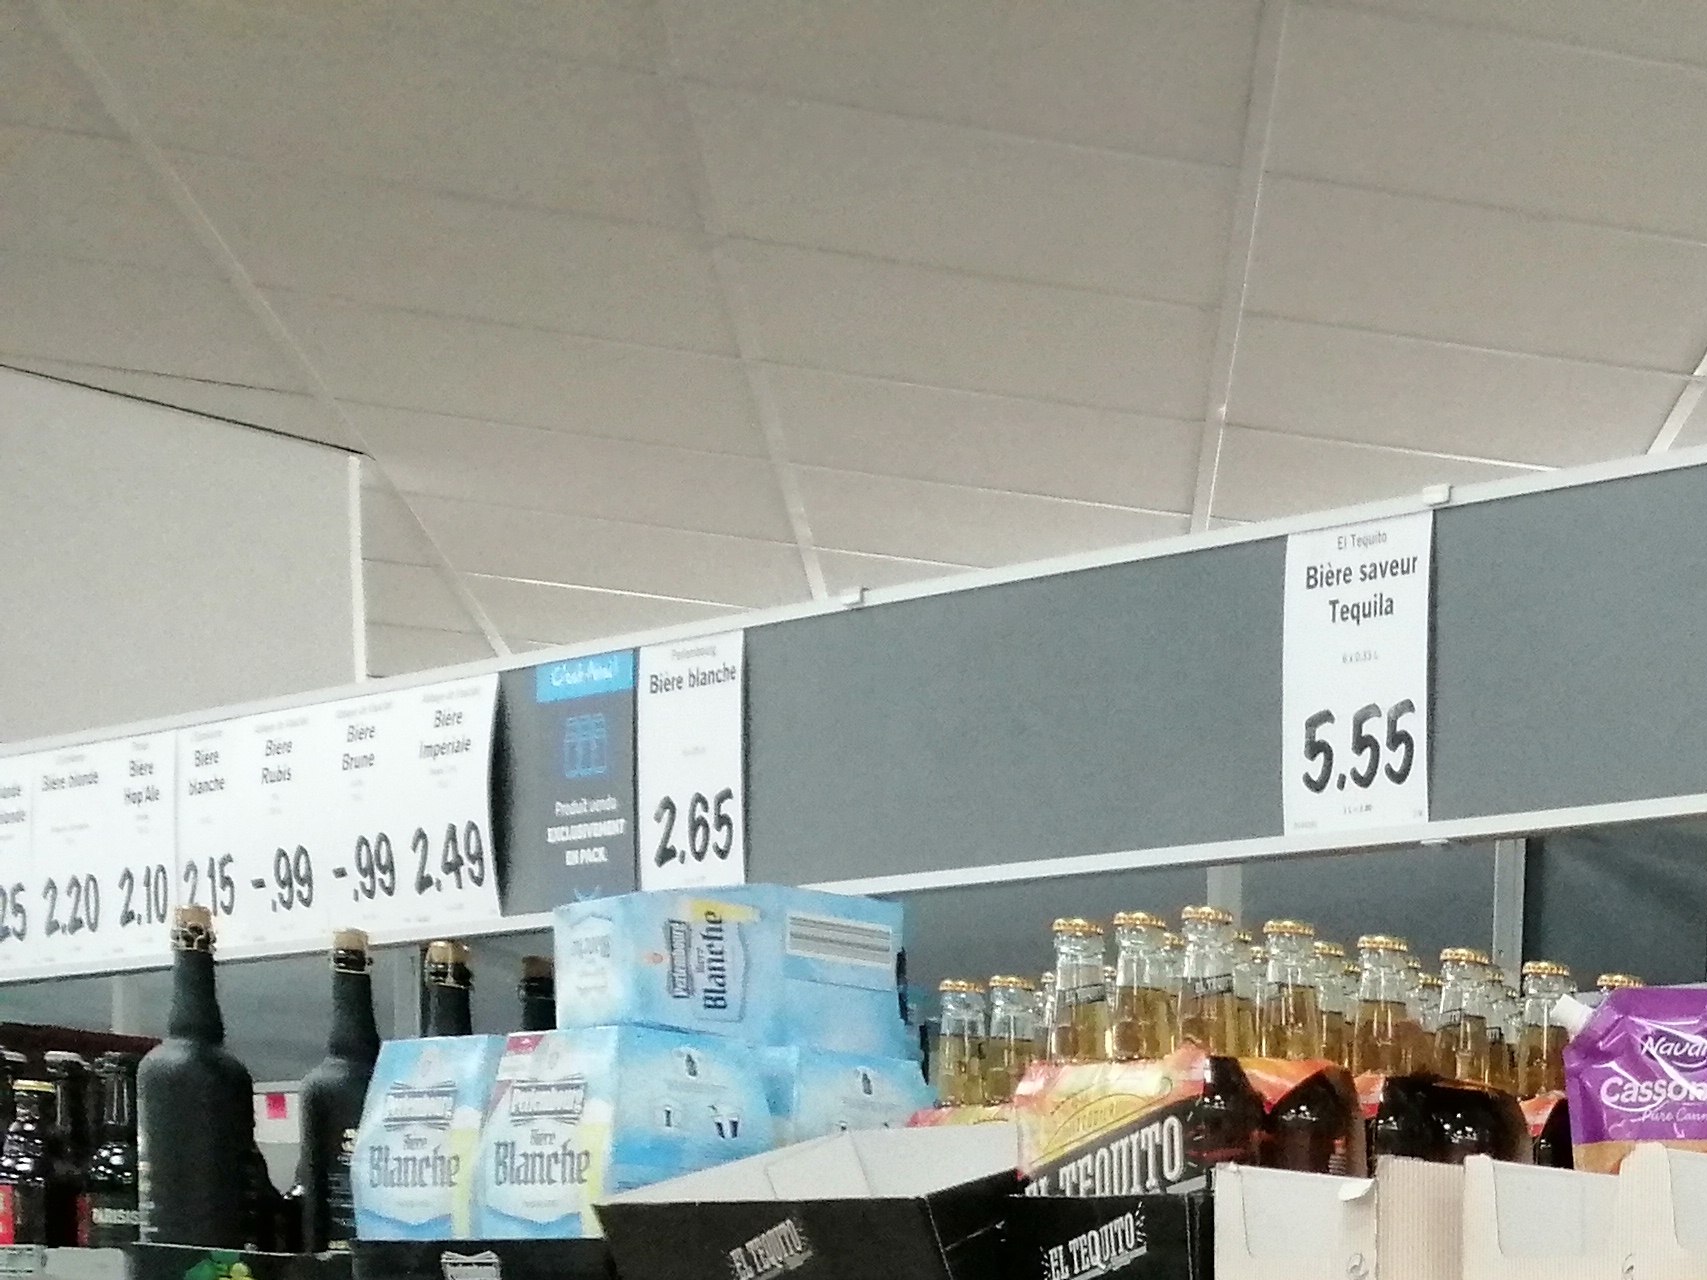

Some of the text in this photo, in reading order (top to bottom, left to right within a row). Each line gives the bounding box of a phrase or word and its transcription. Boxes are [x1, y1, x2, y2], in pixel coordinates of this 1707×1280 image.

[1338, 533, 1388, 549] El Tequito
[1306, 556, 1418, 590] Bière saveur
[1329, 593, 1394, 625] Tequila
[650, 662, 736, 694] Bière blanche
[347, 725, 375, 742] Bière
[434, 710, 462, 728] Bière
[342, 752, 375, 770] Brune
[1303, 699, 1415, 794] 5.55
[261, 766, 292, 784] Rubis
[654, 788, 734, 868] 2.65
[251, 845, 313, 912] -.99
[333, 832, 396, 902] -.99
[412, 820, 485, 895] 2.49
[43, 873, 100, 936] 2.20
[118, 864, 168, 927] 2.10
[369, 1142, 461, 1188] Blanche
[494, 1139, 591, 1186] Blanche
[730, 1219, 803, 1280] EL TEQUITO
[1068, 1212, 1135, 1274] TEQUITO
